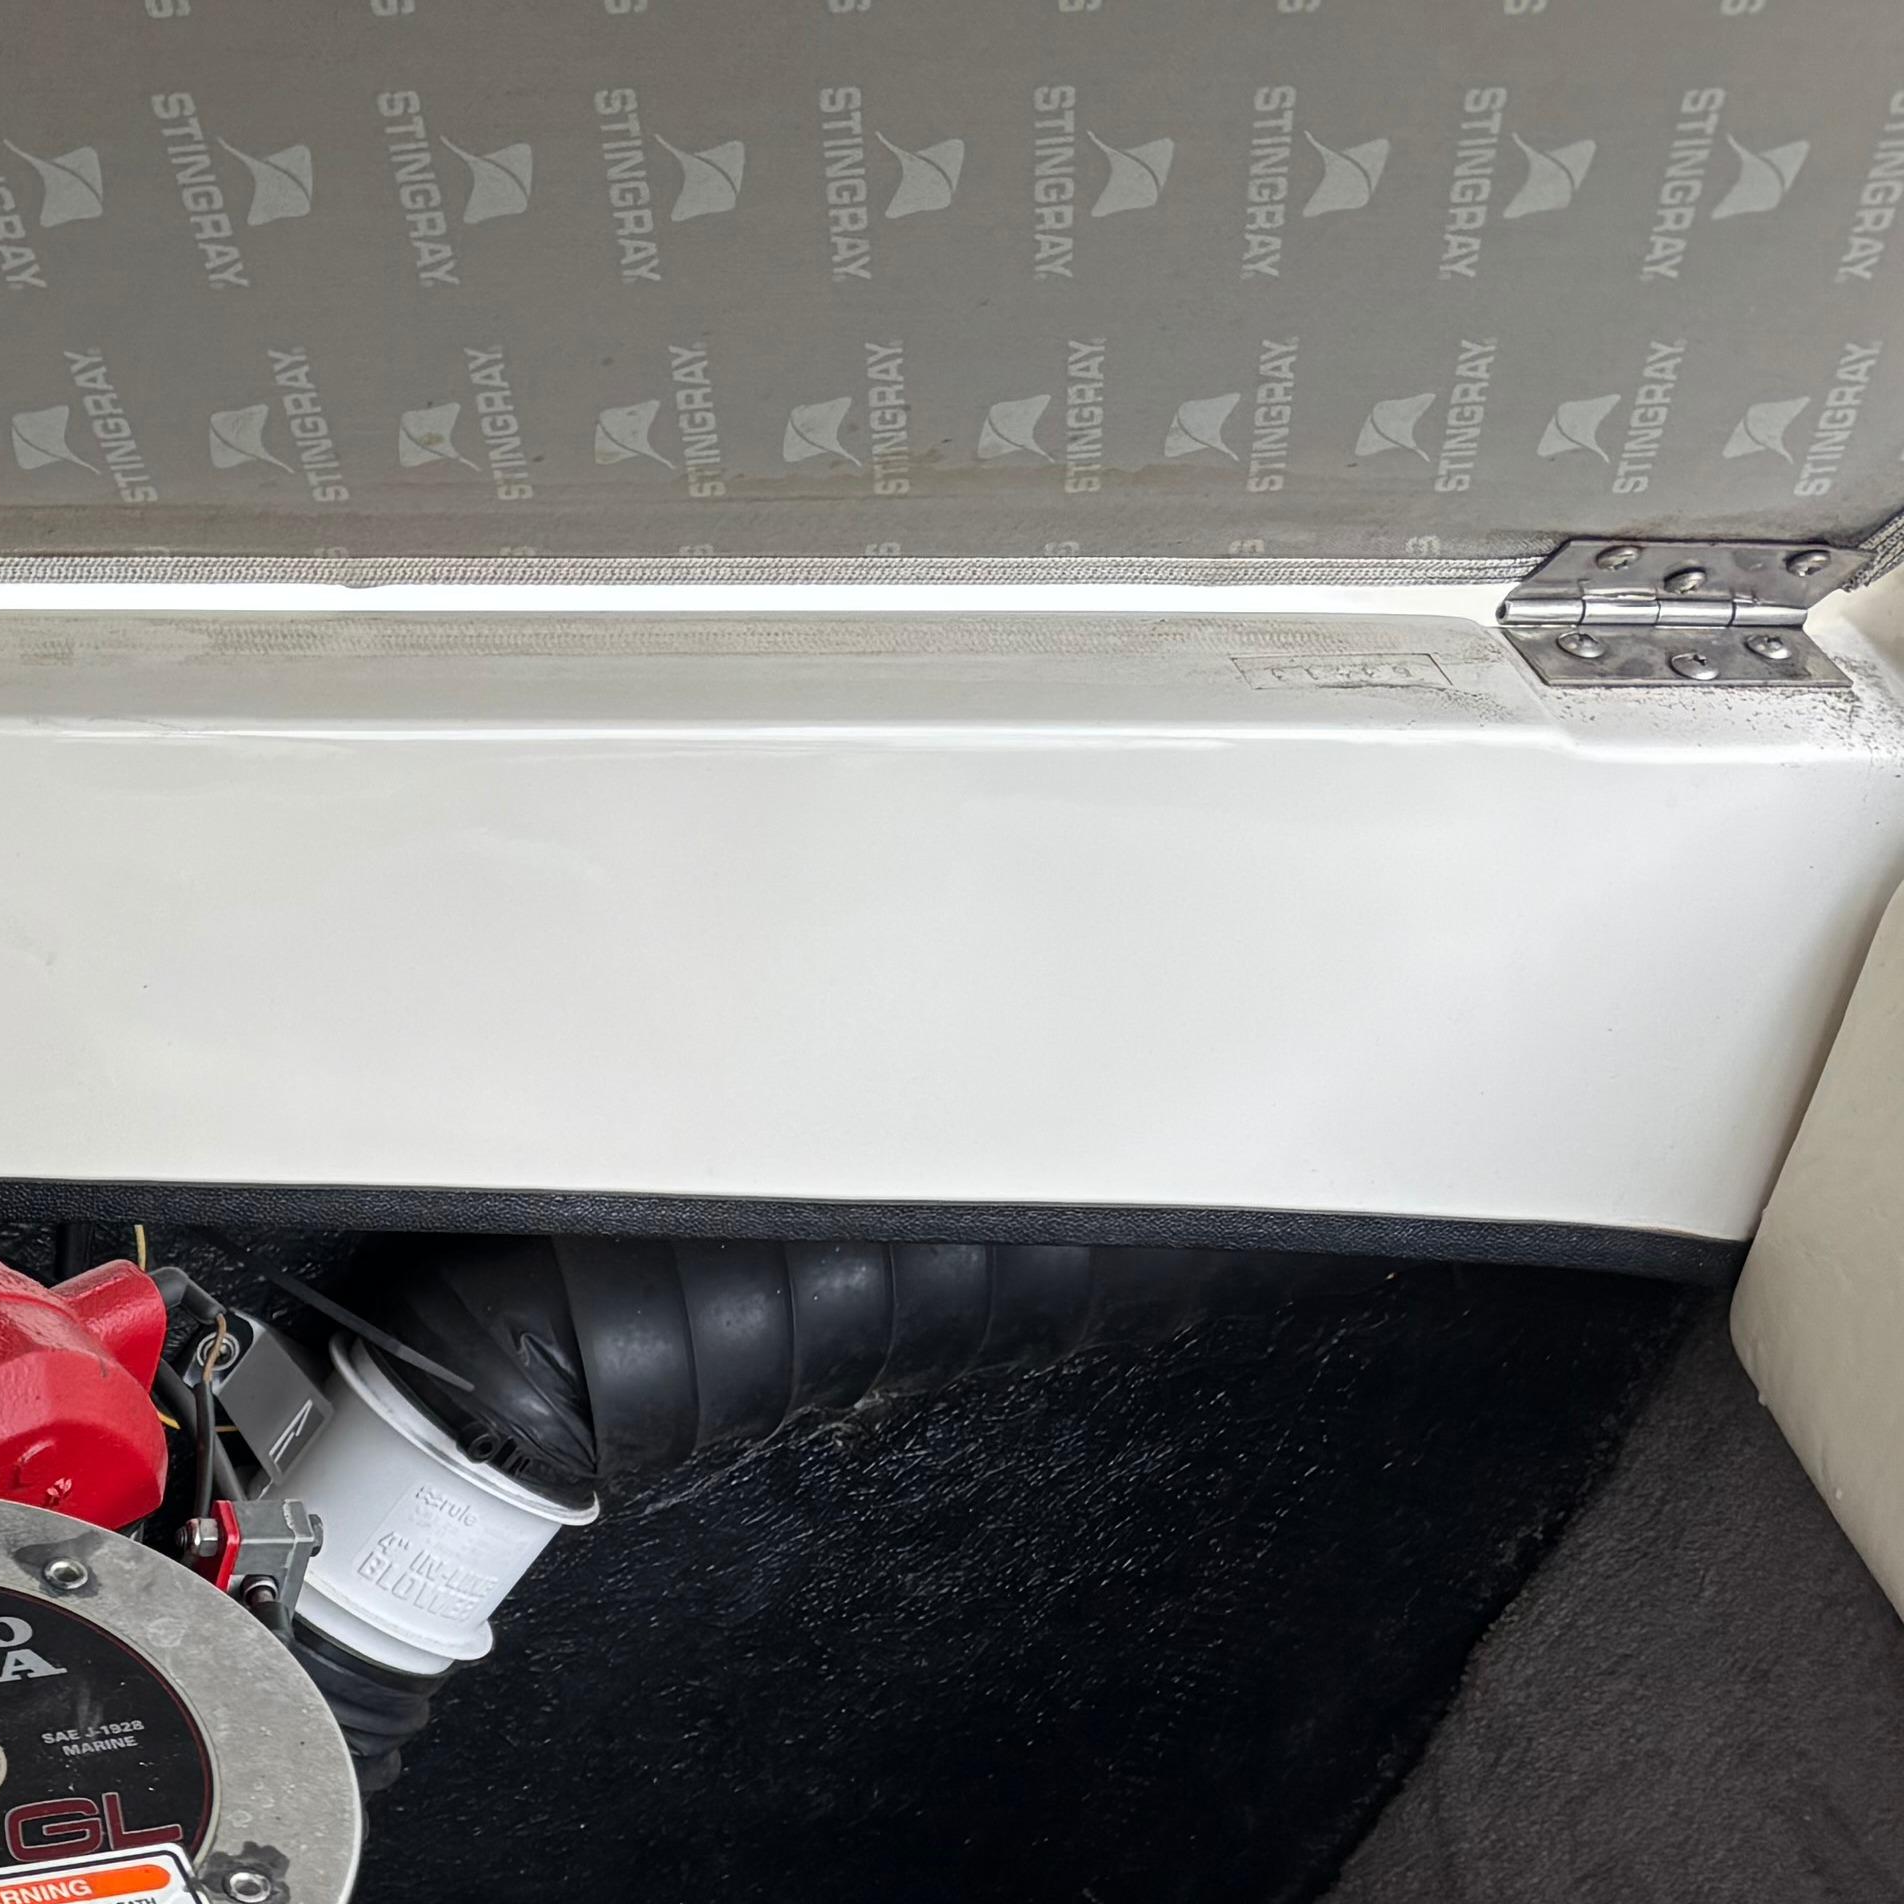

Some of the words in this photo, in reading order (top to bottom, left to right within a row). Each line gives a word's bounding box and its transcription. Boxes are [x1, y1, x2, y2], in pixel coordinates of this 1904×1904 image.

[151, 92, 249, 288] STINGRAY
[377, 90, 460, 286] STINGRAY
[594, 88, 661, 284] STINGRAY
[819, 86, 872, 282] STINGRAY
[1033, 84, 1076, 279] STINGRAY
[1242, 85, 1296, 279] STINGRAY
[1439, 85, 1508, 279] STINGRAY
[1640, 86, 1726, 281] STINGRAY
[63, 347, 158, 503] STINGRAY
[267, 347, 350, 502] STINGRAY
[463, 346, 533, 501] STINGRAY
[668, 342, 726, 498] STINGRAY
[864, 341, 910, 495] STINGRAY
[1064, 339, 1106, 493] STINGRAY
[1247, 337, 1300, 493] STINGRAY
[1434, 337, 1498, 493] STINGRAY
[1612, 339, 1687, 494] STINGRAY
[1794, 340, 1883, 497] STINGRAY
[42, 1729, 78, 1745] SAE
[62, 1735, 138, 1756] MARINE
